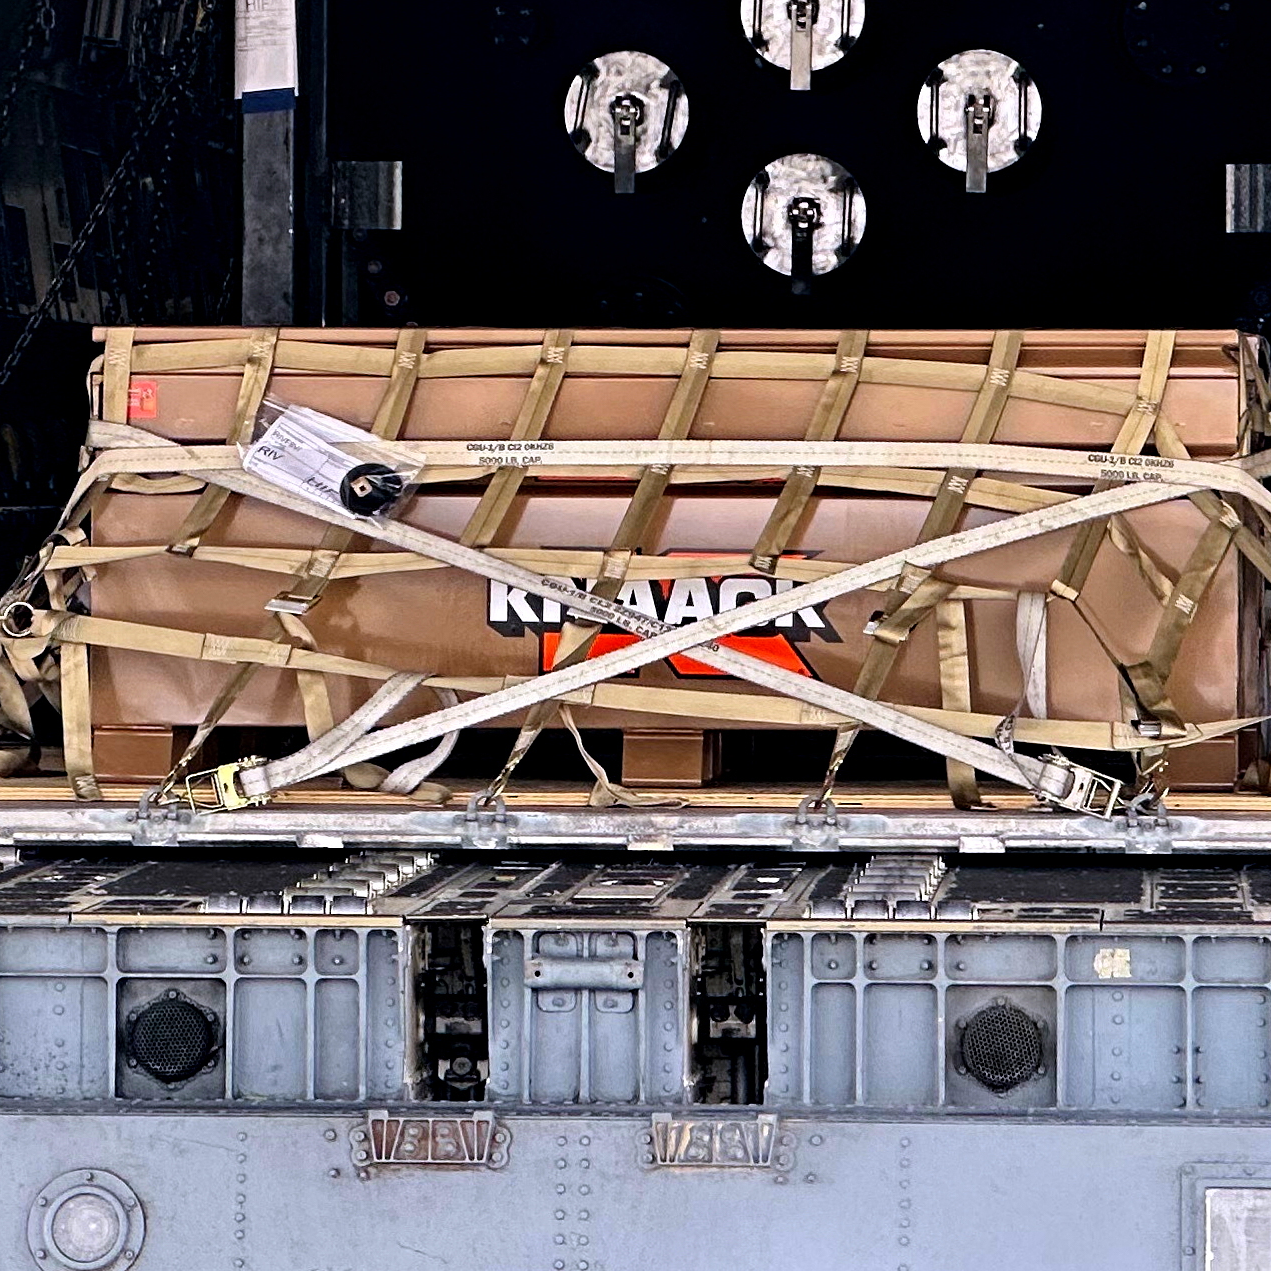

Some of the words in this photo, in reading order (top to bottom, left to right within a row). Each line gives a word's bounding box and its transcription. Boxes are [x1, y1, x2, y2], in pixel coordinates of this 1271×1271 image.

[257, 444, 284, 461] RIV
[479, 456, 504, 465] 5000
[1087, 454, 1127, 466] CGU-1/B
[1100, 469, 1125, 479] 5000
